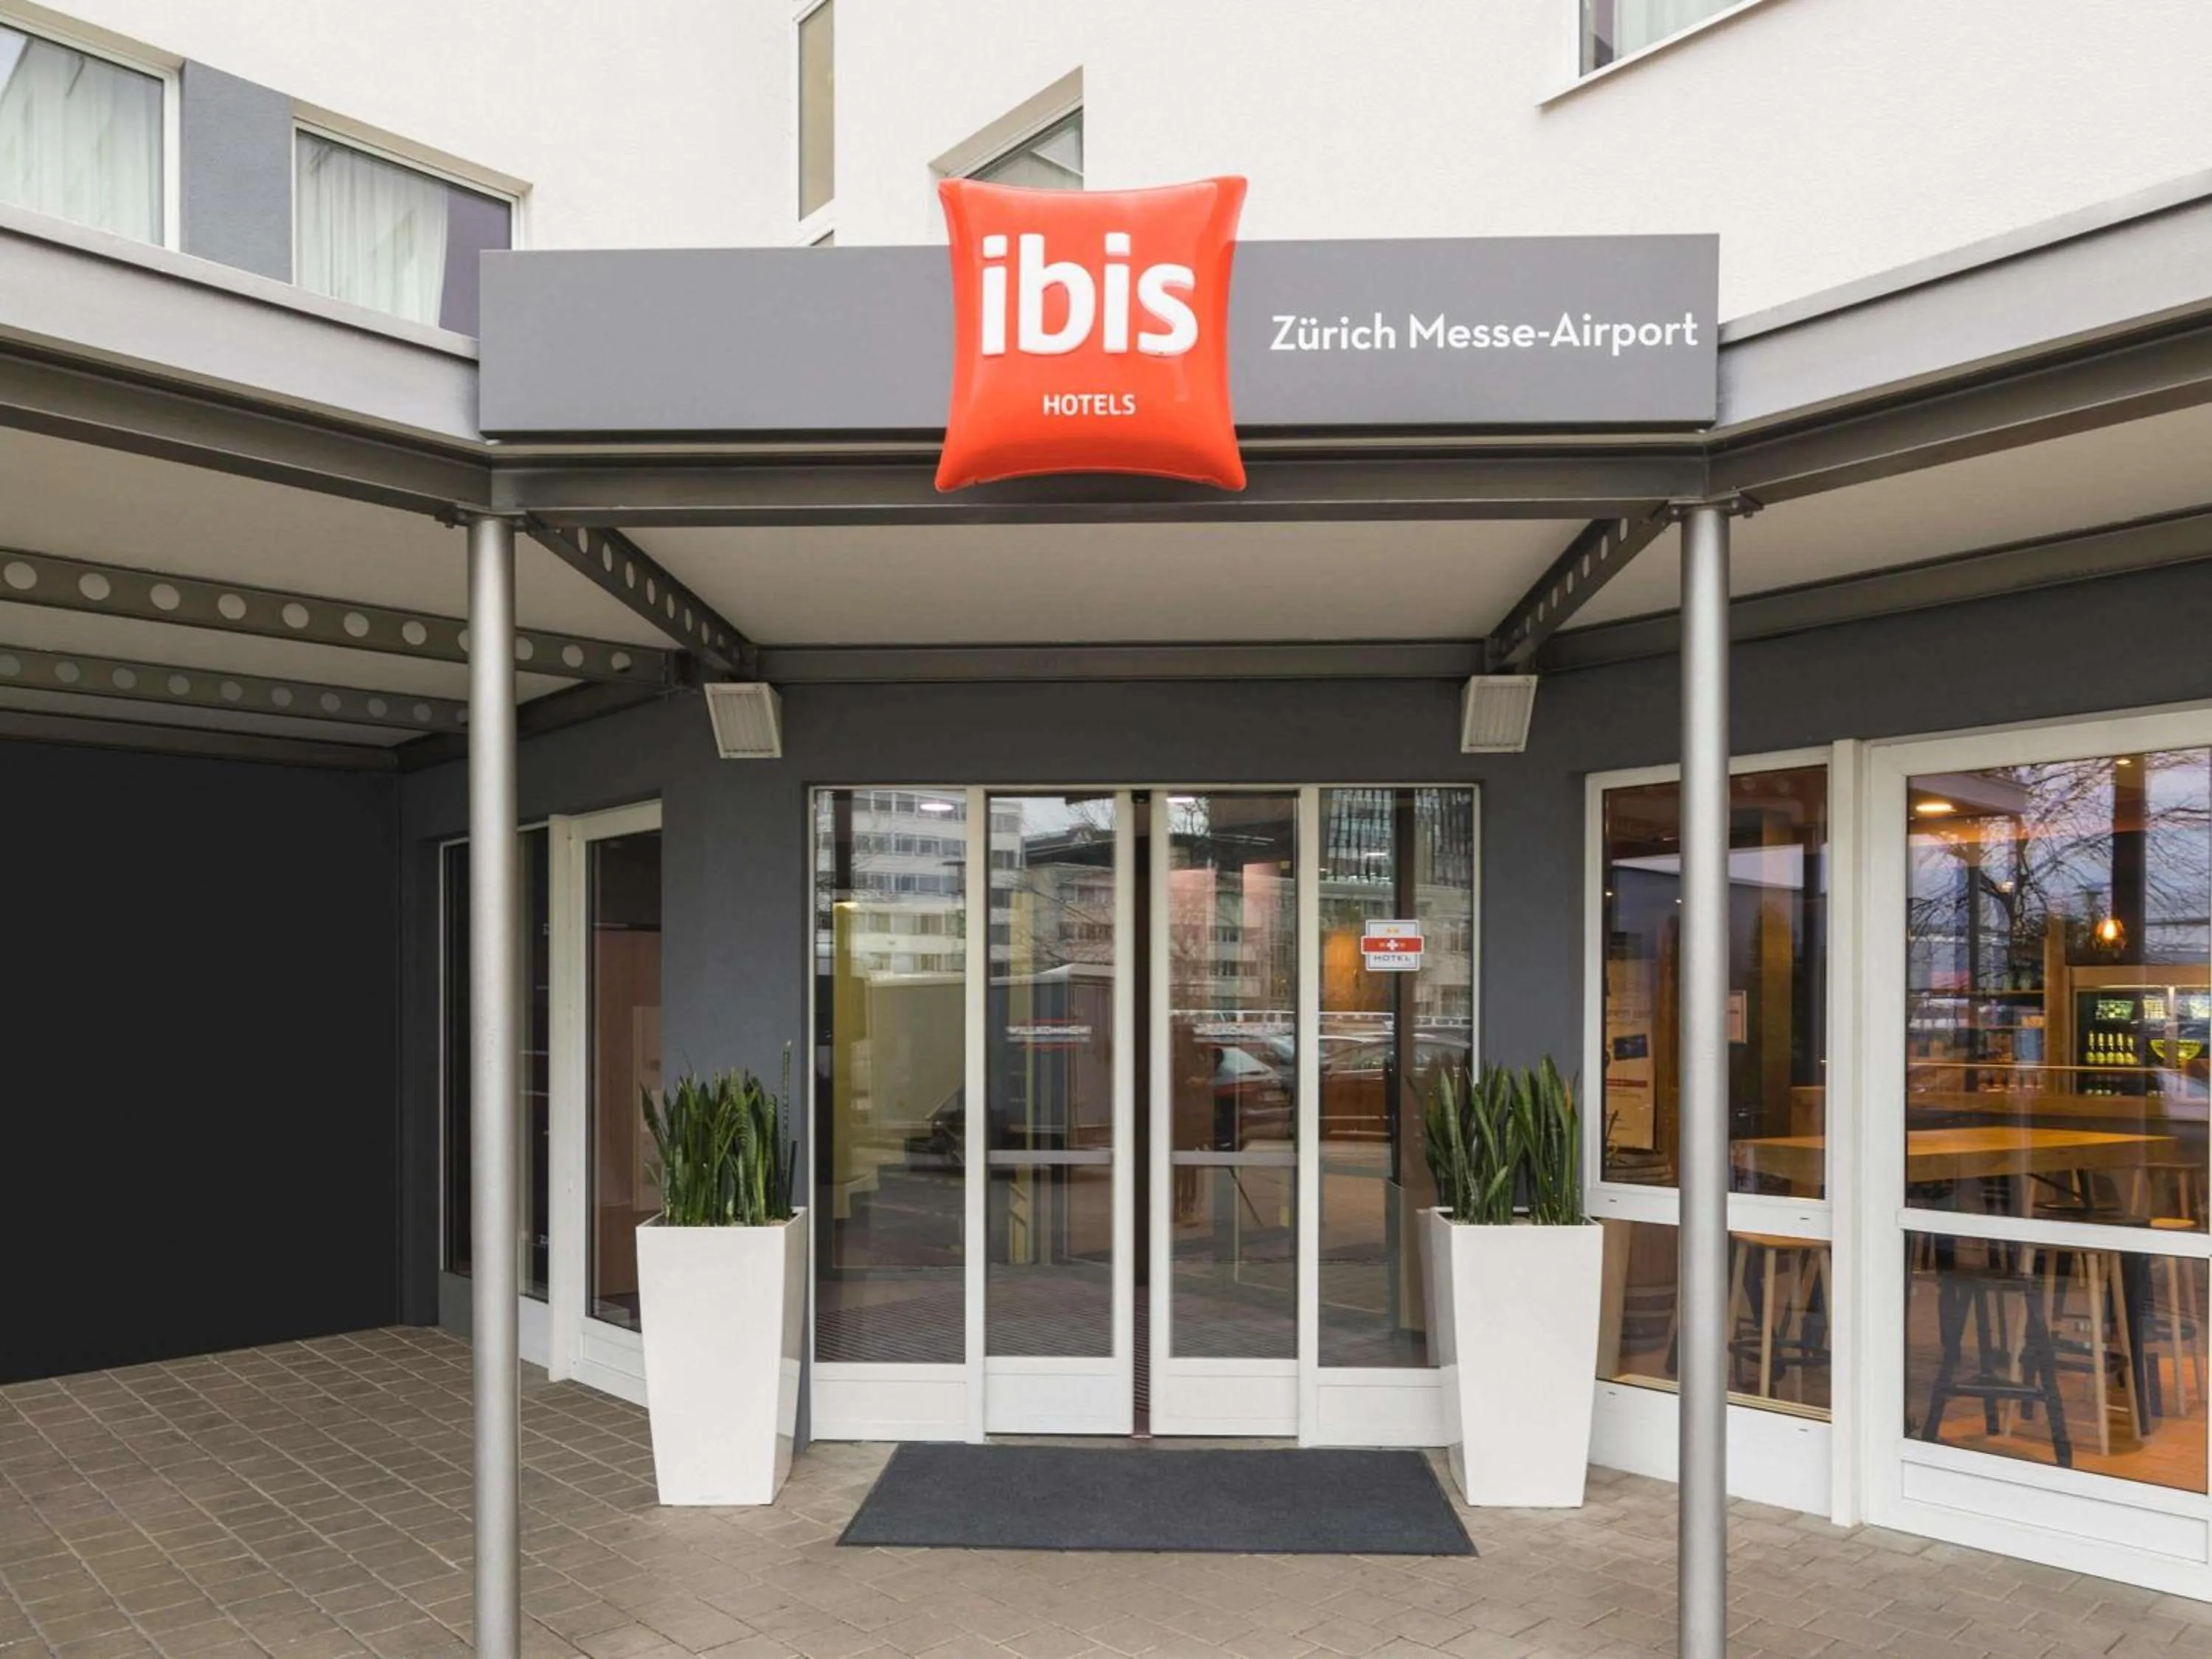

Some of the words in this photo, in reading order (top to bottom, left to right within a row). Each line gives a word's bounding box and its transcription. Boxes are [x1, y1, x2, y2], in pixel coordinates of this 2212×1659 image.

[981, 232, 1198, 355] ibis
[1270, 312, 1397, 351] Zürich
[1409, 312, 1699, 357] Messe-Airport
[1043, 394, 1135, 416] HOTELS
